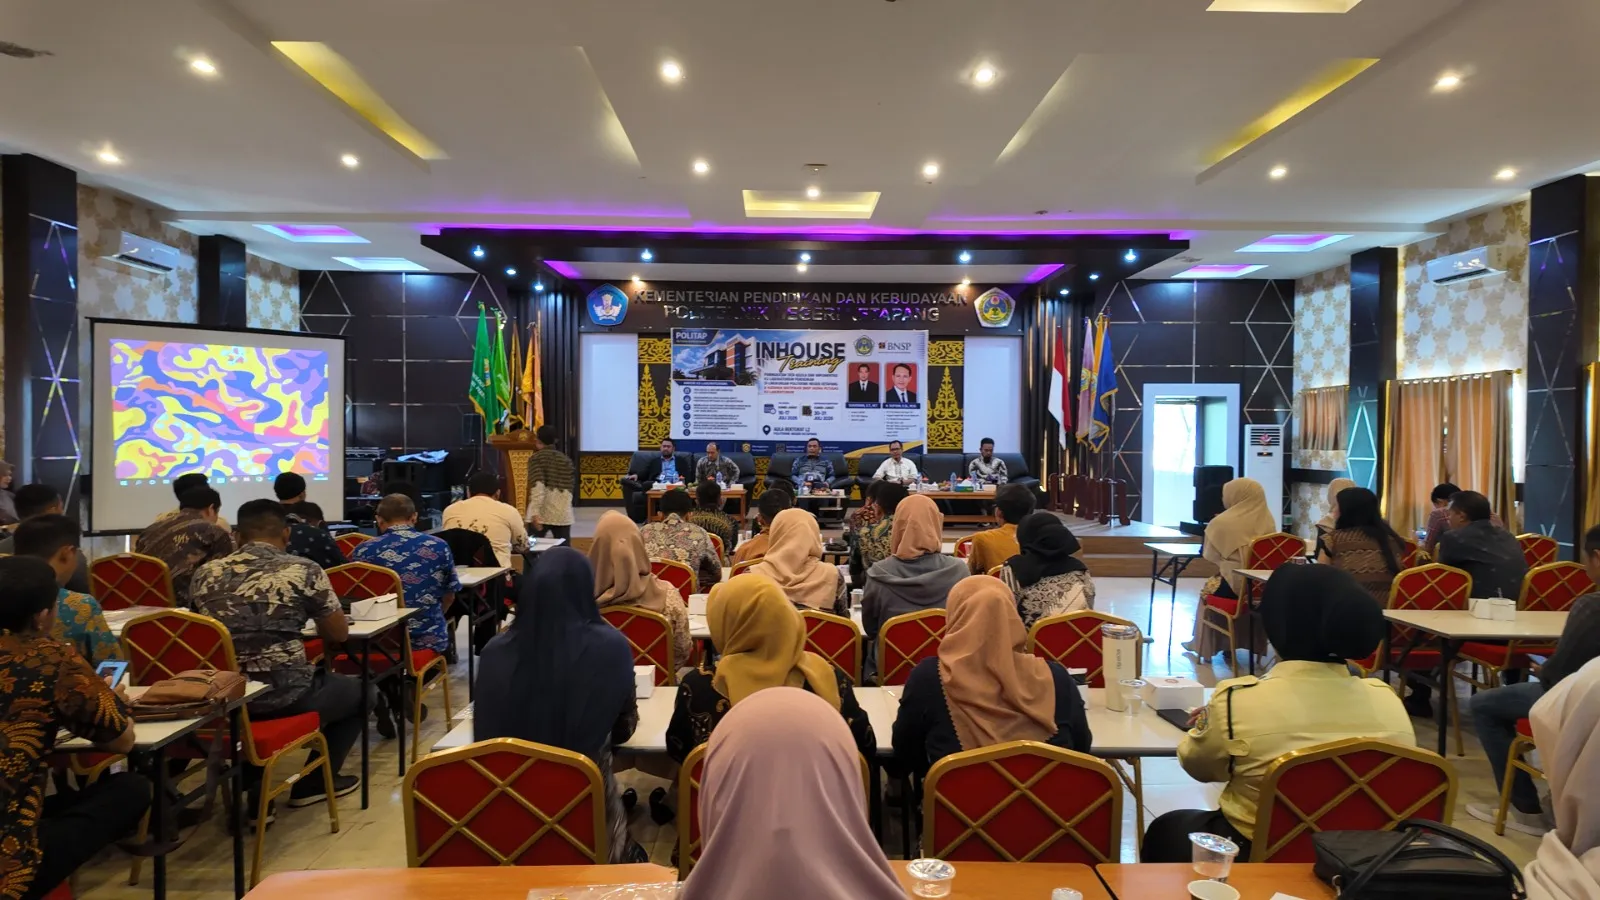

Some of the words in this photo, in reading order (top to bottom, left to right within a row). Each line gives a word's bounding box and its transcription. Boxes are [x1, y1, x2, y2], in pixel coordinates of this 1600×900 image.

[634, 290, 739, 304] KEMENTERIAN
[743, 291, 831, 304] PENDIDIKAN
[836, 292, 866, 304] DAN
[871, 292, 967, 306] KEBUDAYAAN
[664, 305, 770, 321] POLTENIK
[777, 306, 841, 321] EGERI
[846, 306, 940, 322] ETAPANG
[675, 332, 708, 340] POLITAP
[755, 341, 846, 360] INHOUSE
[887, 342, 912, 351] BNSP
[776, 354, 846, 373] Training
